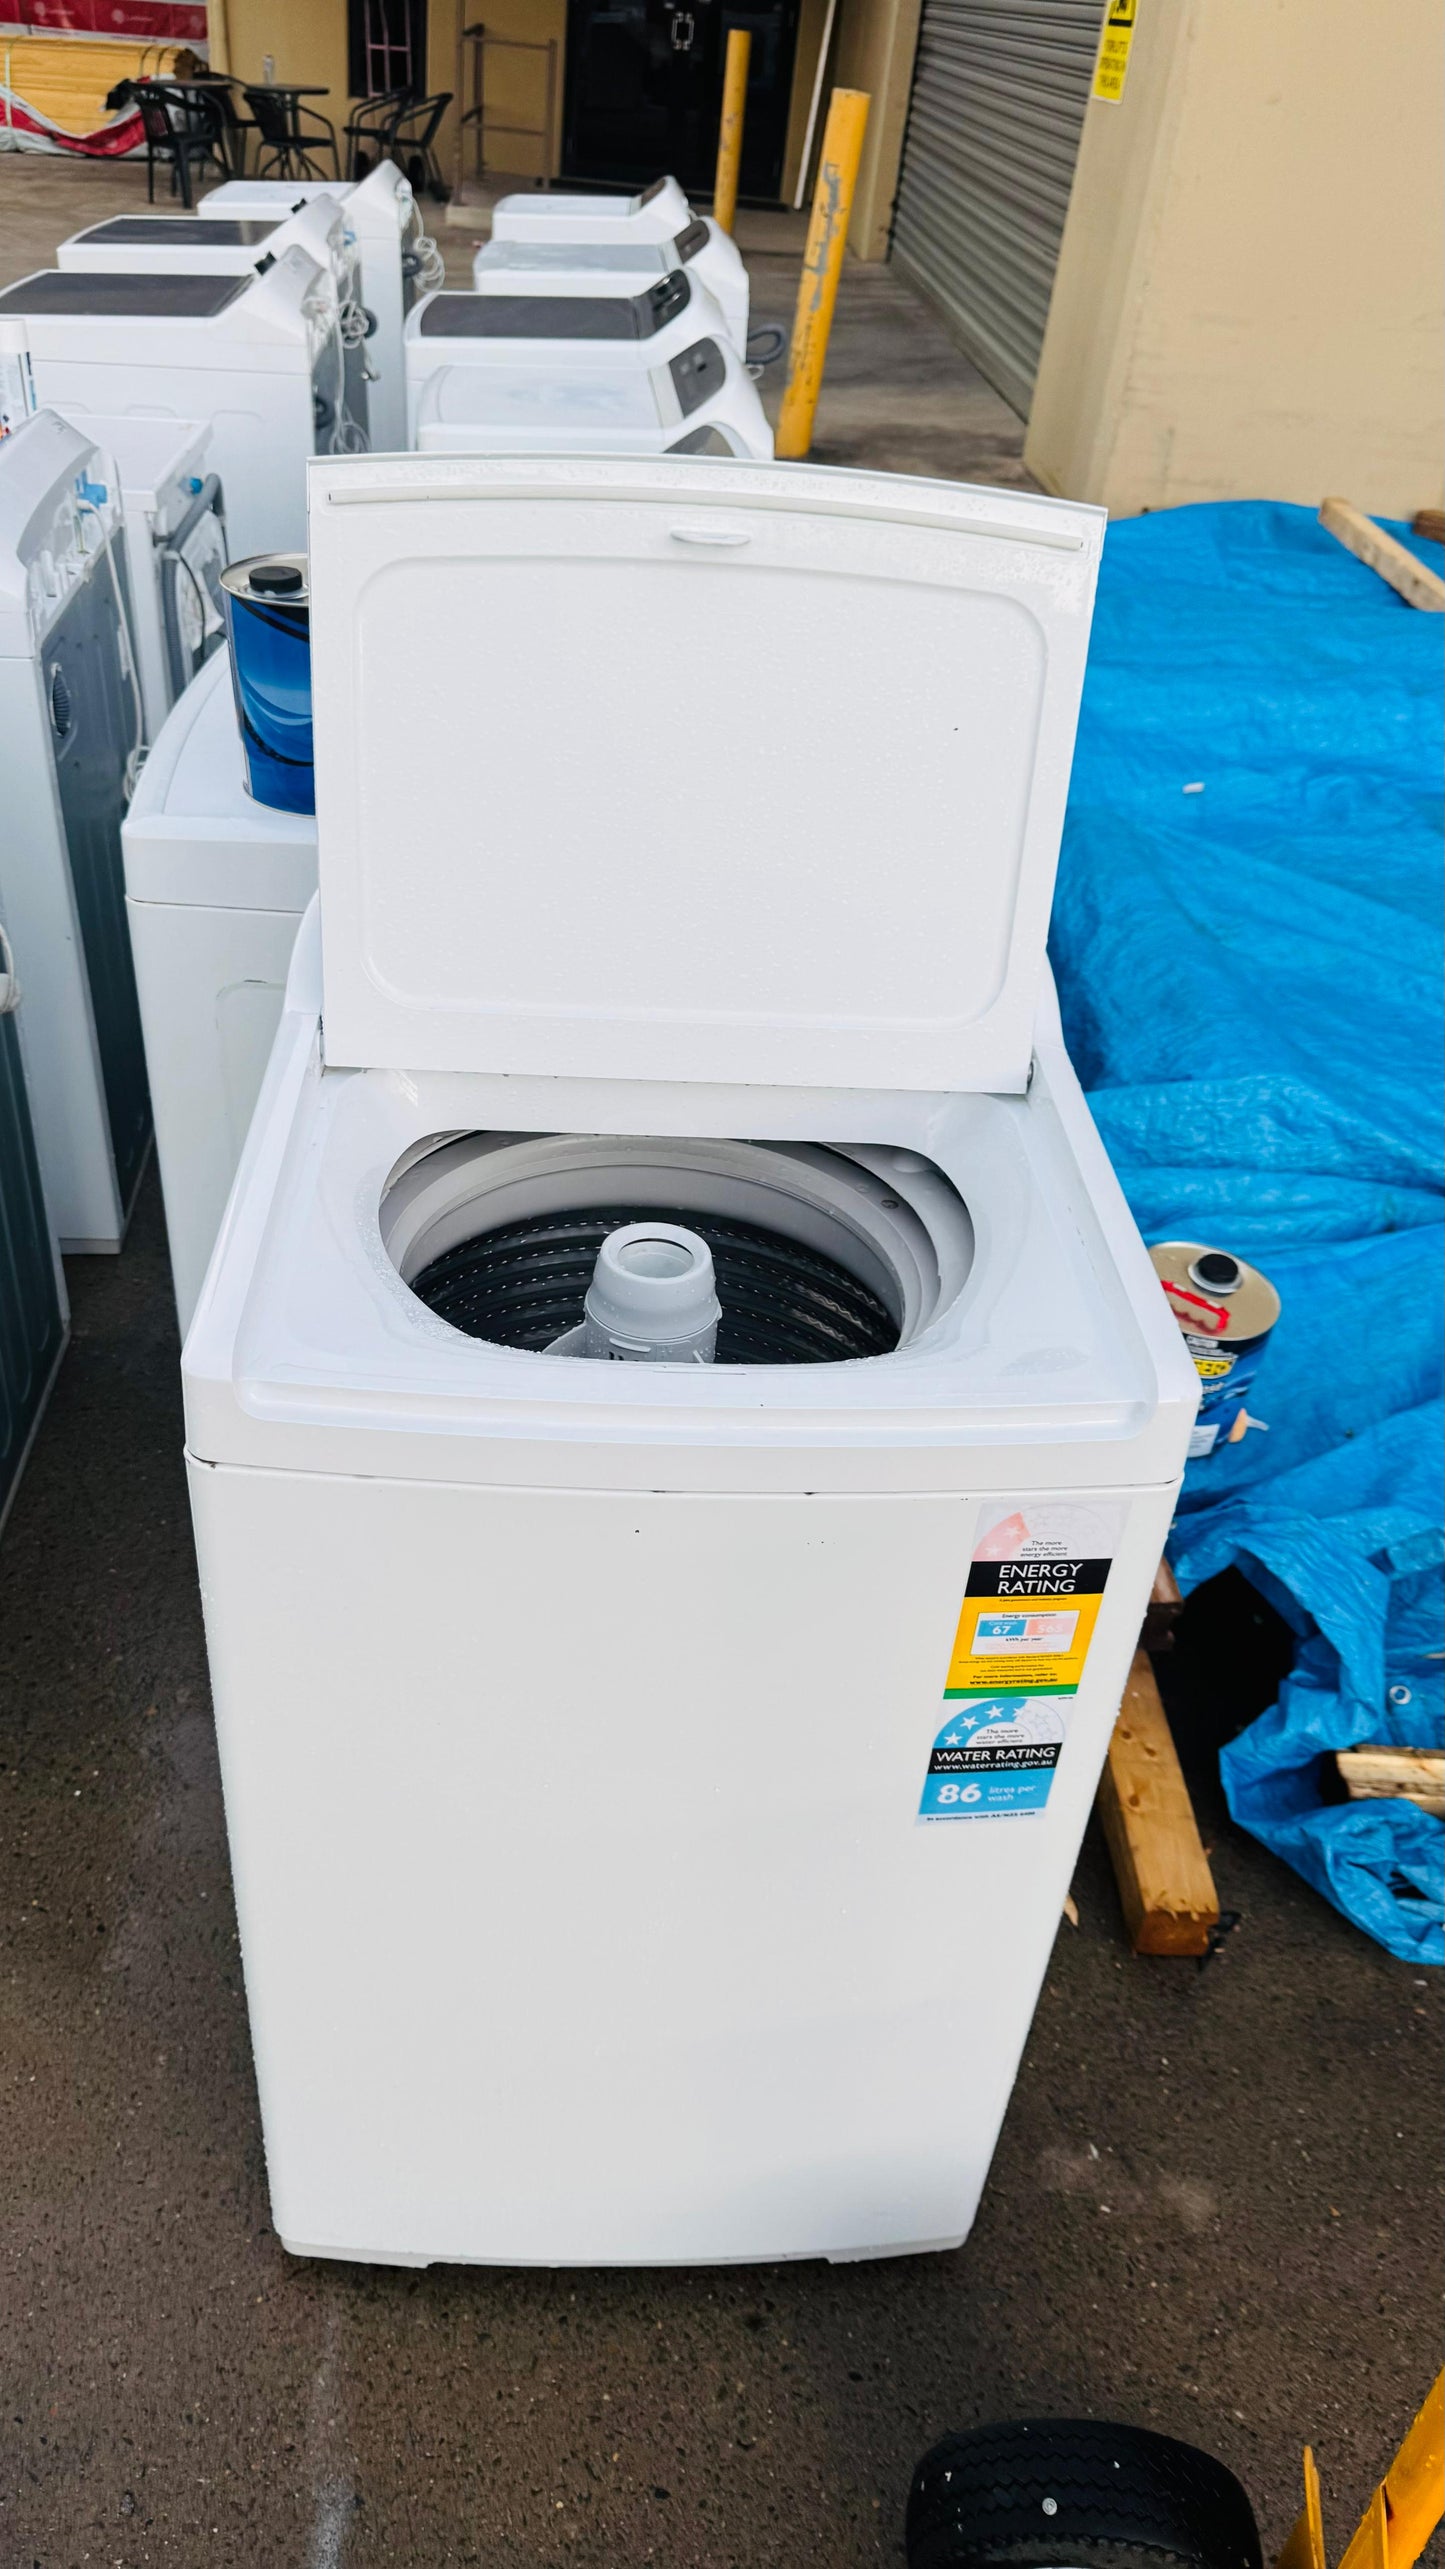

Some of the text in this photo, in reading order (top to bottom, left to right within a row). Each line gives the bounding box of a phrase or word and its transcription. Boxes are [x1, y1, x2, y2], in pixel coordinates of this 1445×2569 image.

[998, 1563, 1083, 1578] ENERGY
[997, 1579, 1076, 1594] RATING
[992, 1625, 1011, 1635] 67
[936, 1746, 1056, 1763] WATER RATING
[933, 1760, 1053, 1771] www.waterrating.gov.au
[937, 1783, 1036, 1804] 86 litres per
[987, 1794, 1014, 1802] wash
